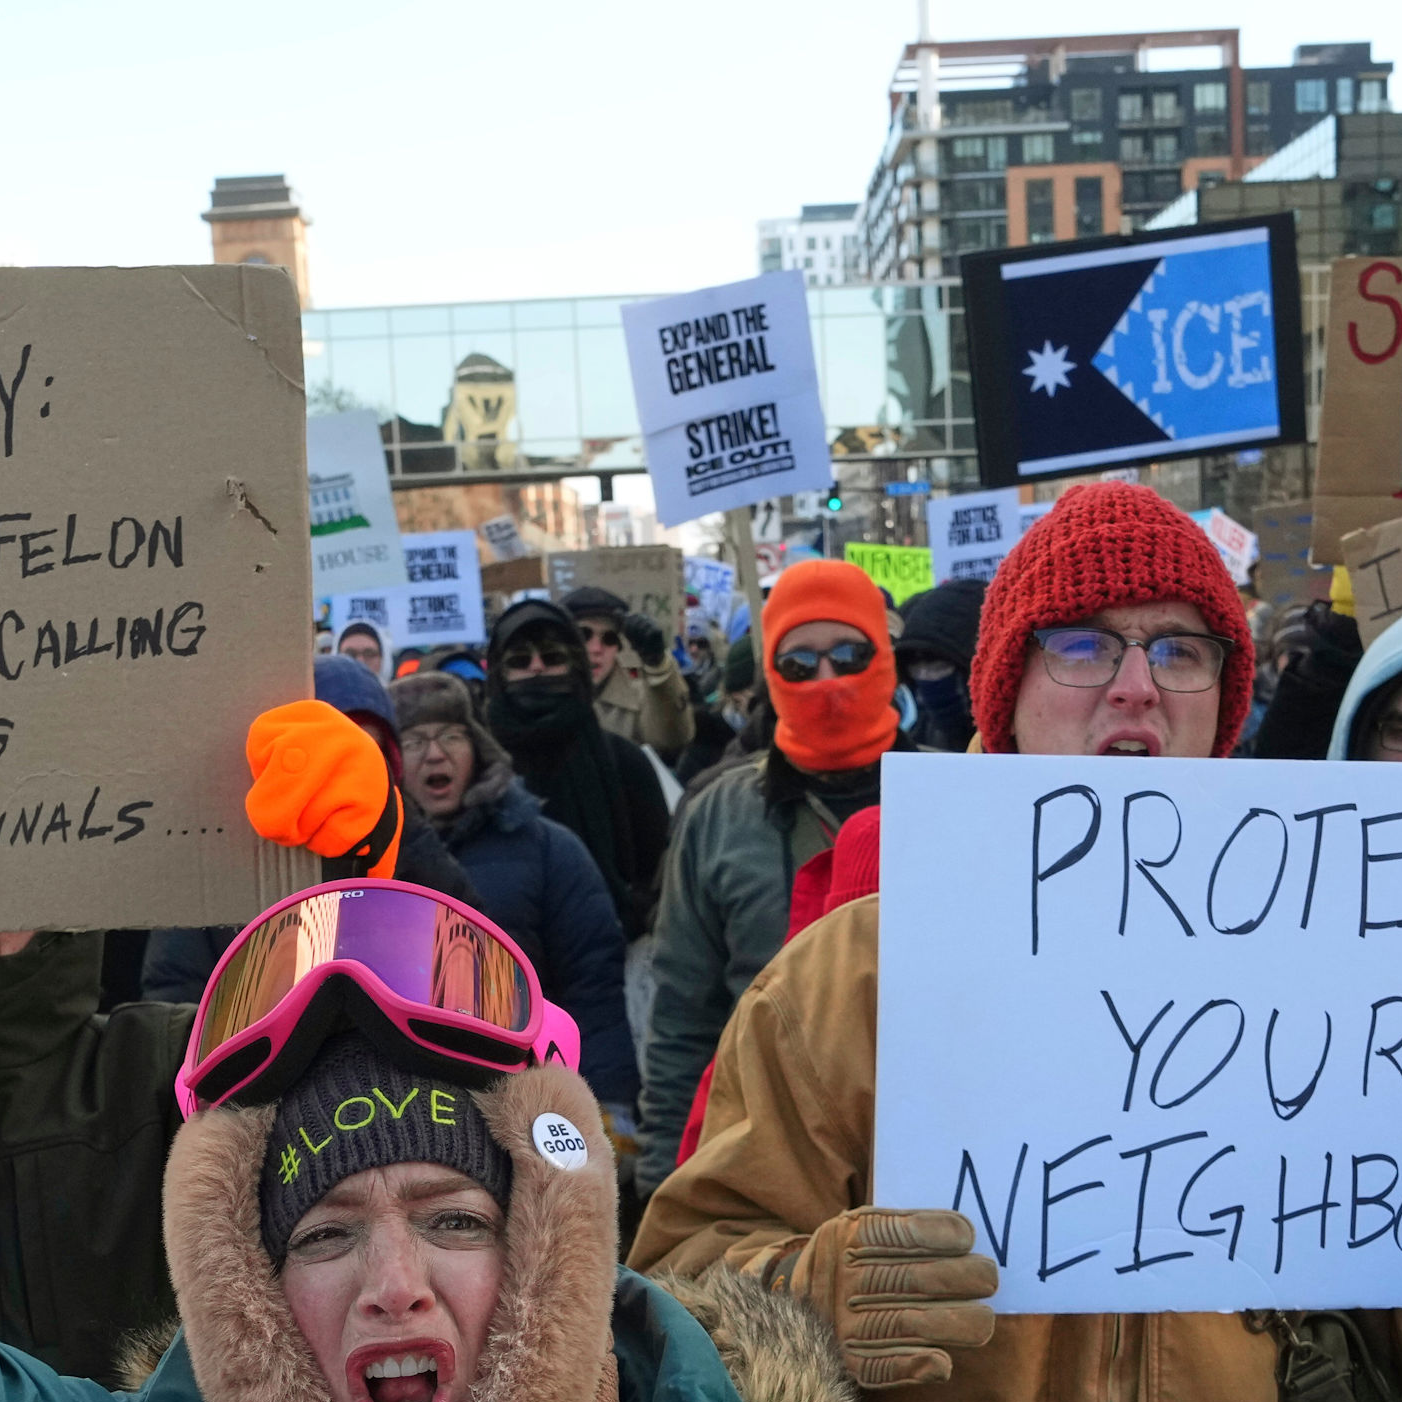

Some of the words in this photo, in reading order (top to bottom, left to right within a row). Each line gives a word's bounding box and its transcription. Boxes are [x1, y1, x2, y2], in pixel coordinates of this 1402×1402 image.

[658, 312, 731, 355] EXPAND
[732, 303, 769, 336] THE
[1147, 290, 1273, 394] ICE
[666, 336, 776, 395] GENERAL
[685, 402, 780, 459] STRIKE!
[686, 455, 723, 478] ICE
[729, 440, 791, 465] OUT!
[317, 545, 389, 572] HOUSE
[279, 1087, 457, 1184] #LOVE
[543, 1138, 586, 1154] GOOD
[548, 1124, 569, 1137] BE
